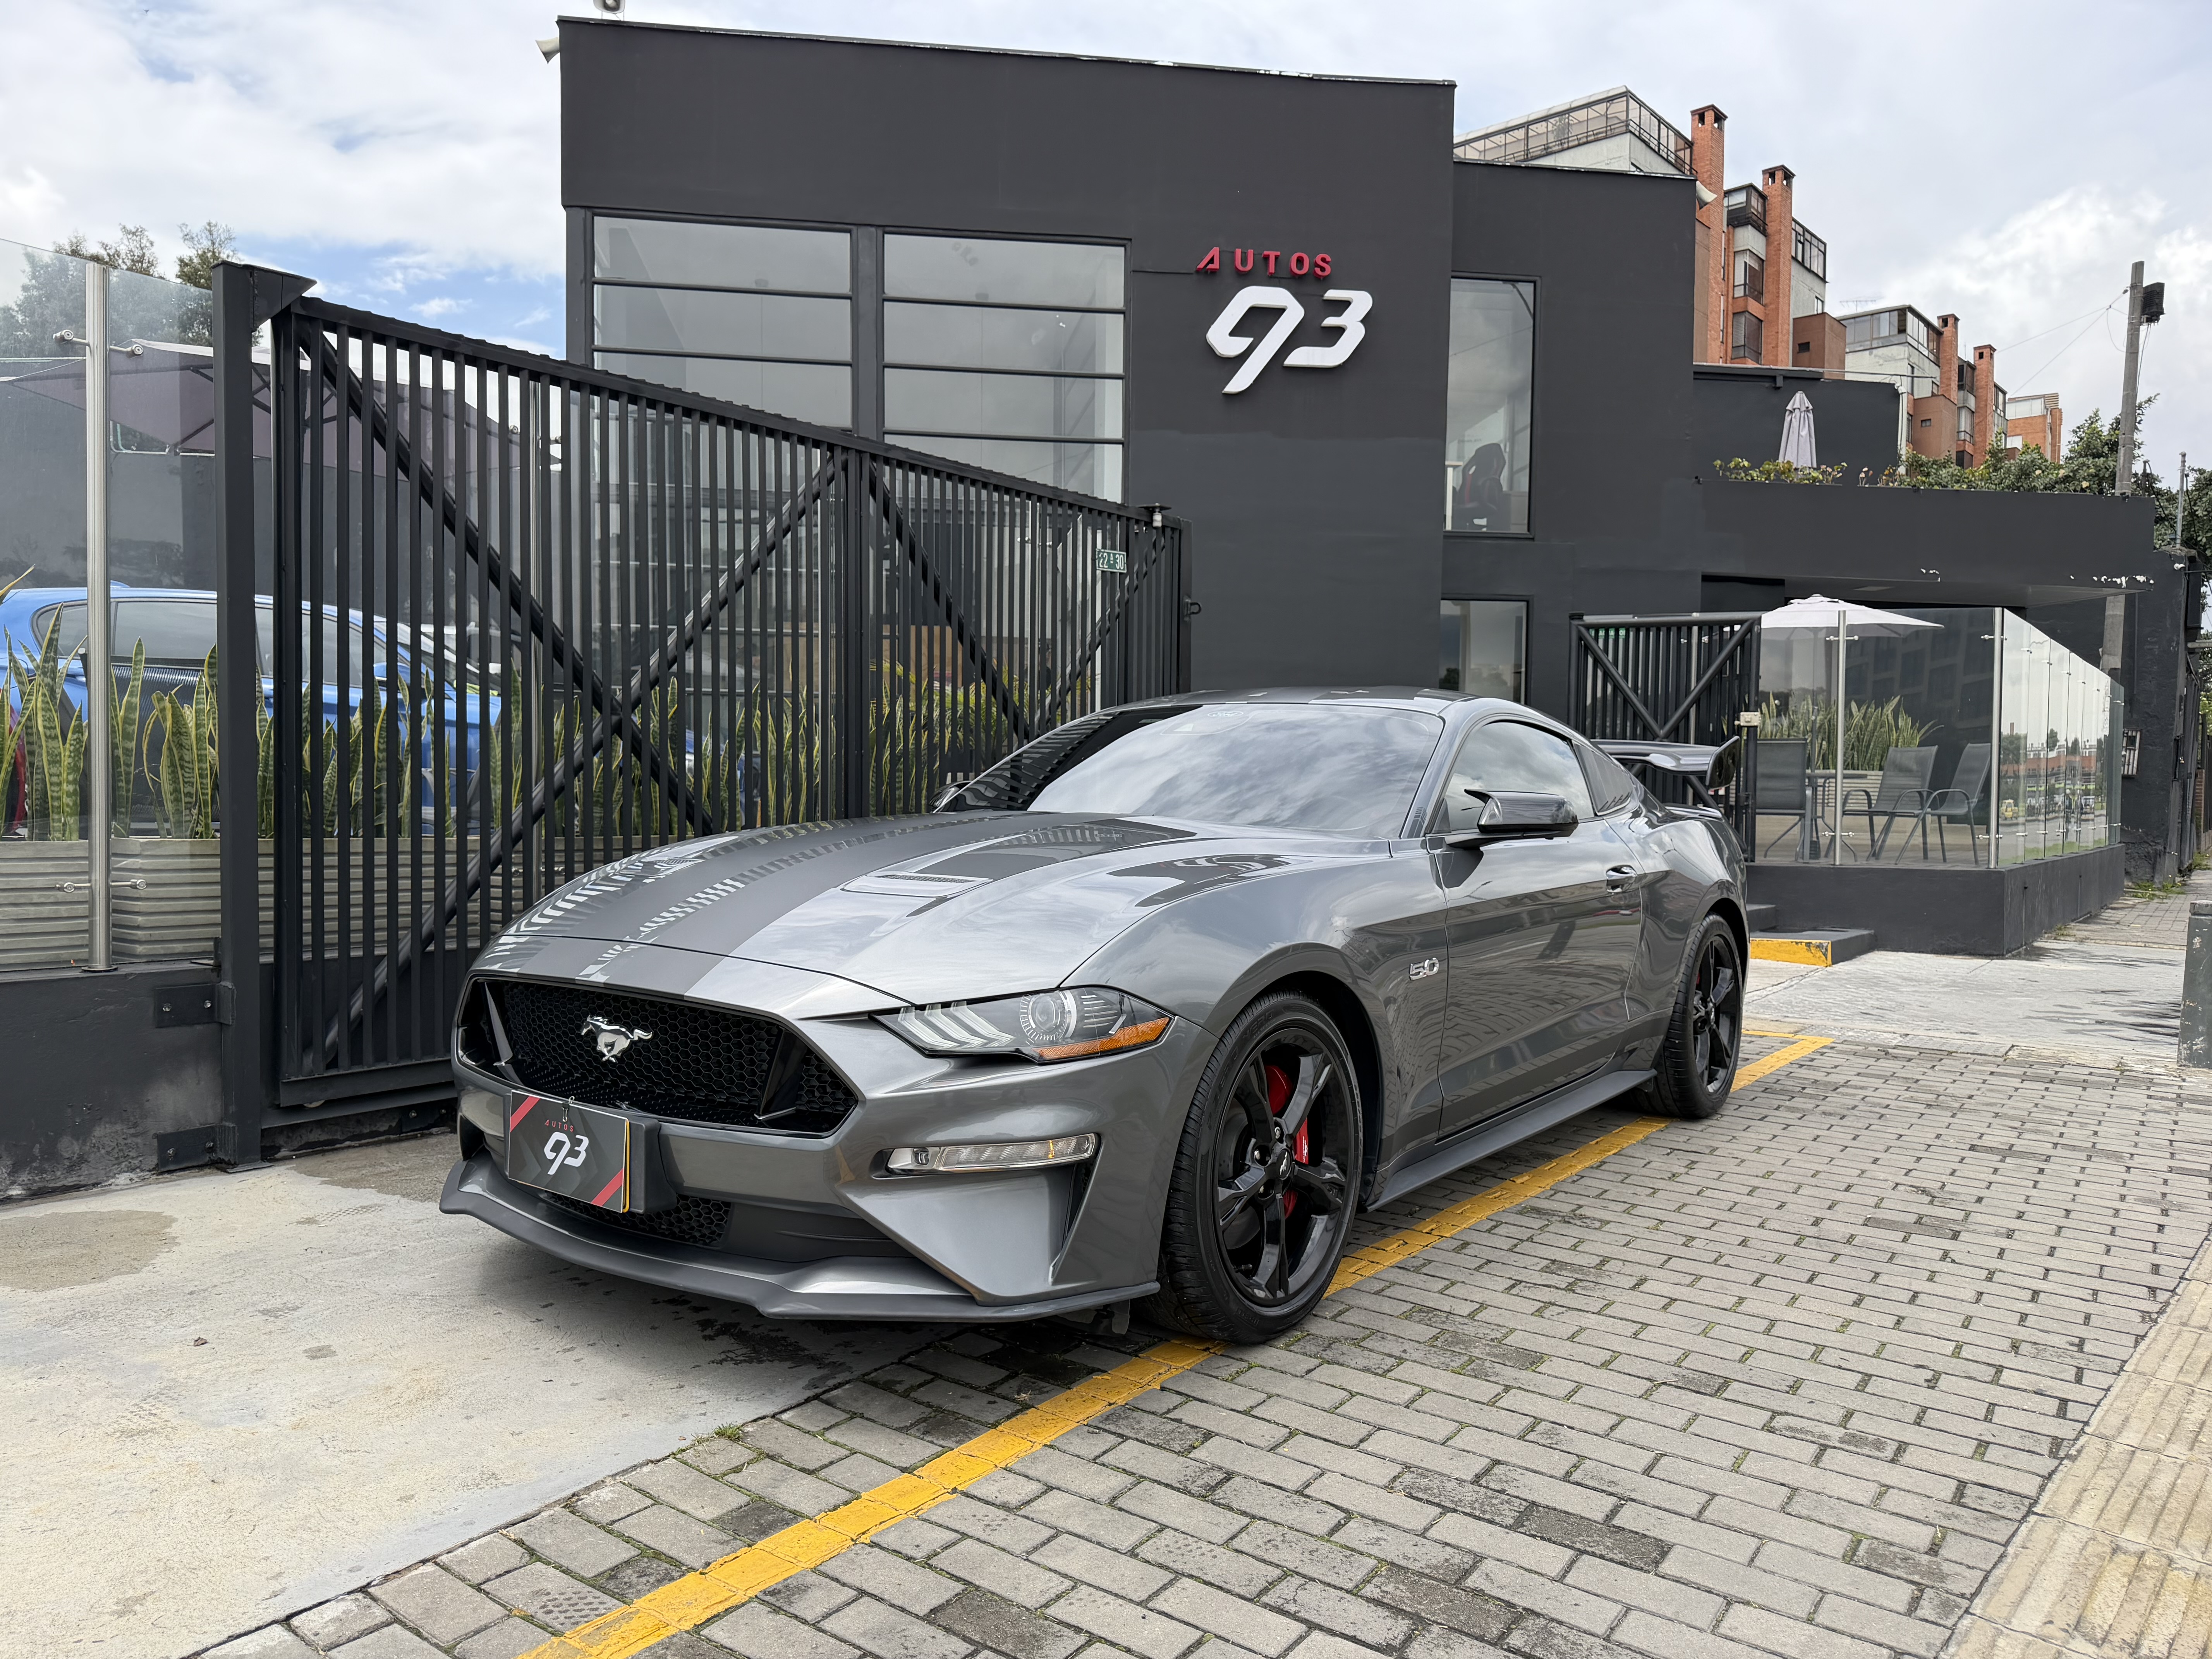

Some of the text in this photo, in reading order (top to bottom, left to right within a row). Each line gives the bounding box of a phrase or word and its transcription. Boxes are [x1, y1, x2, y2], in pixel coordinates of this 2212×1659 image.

[1196, 247, 1331, 278] AUTOS
[1206, 286, 1372, 393] 93
[1115, 554, 1124, 570] 30
[544, 1120, 574, 1132] AUTOS
[544, 1132, 589, 1175] 93
